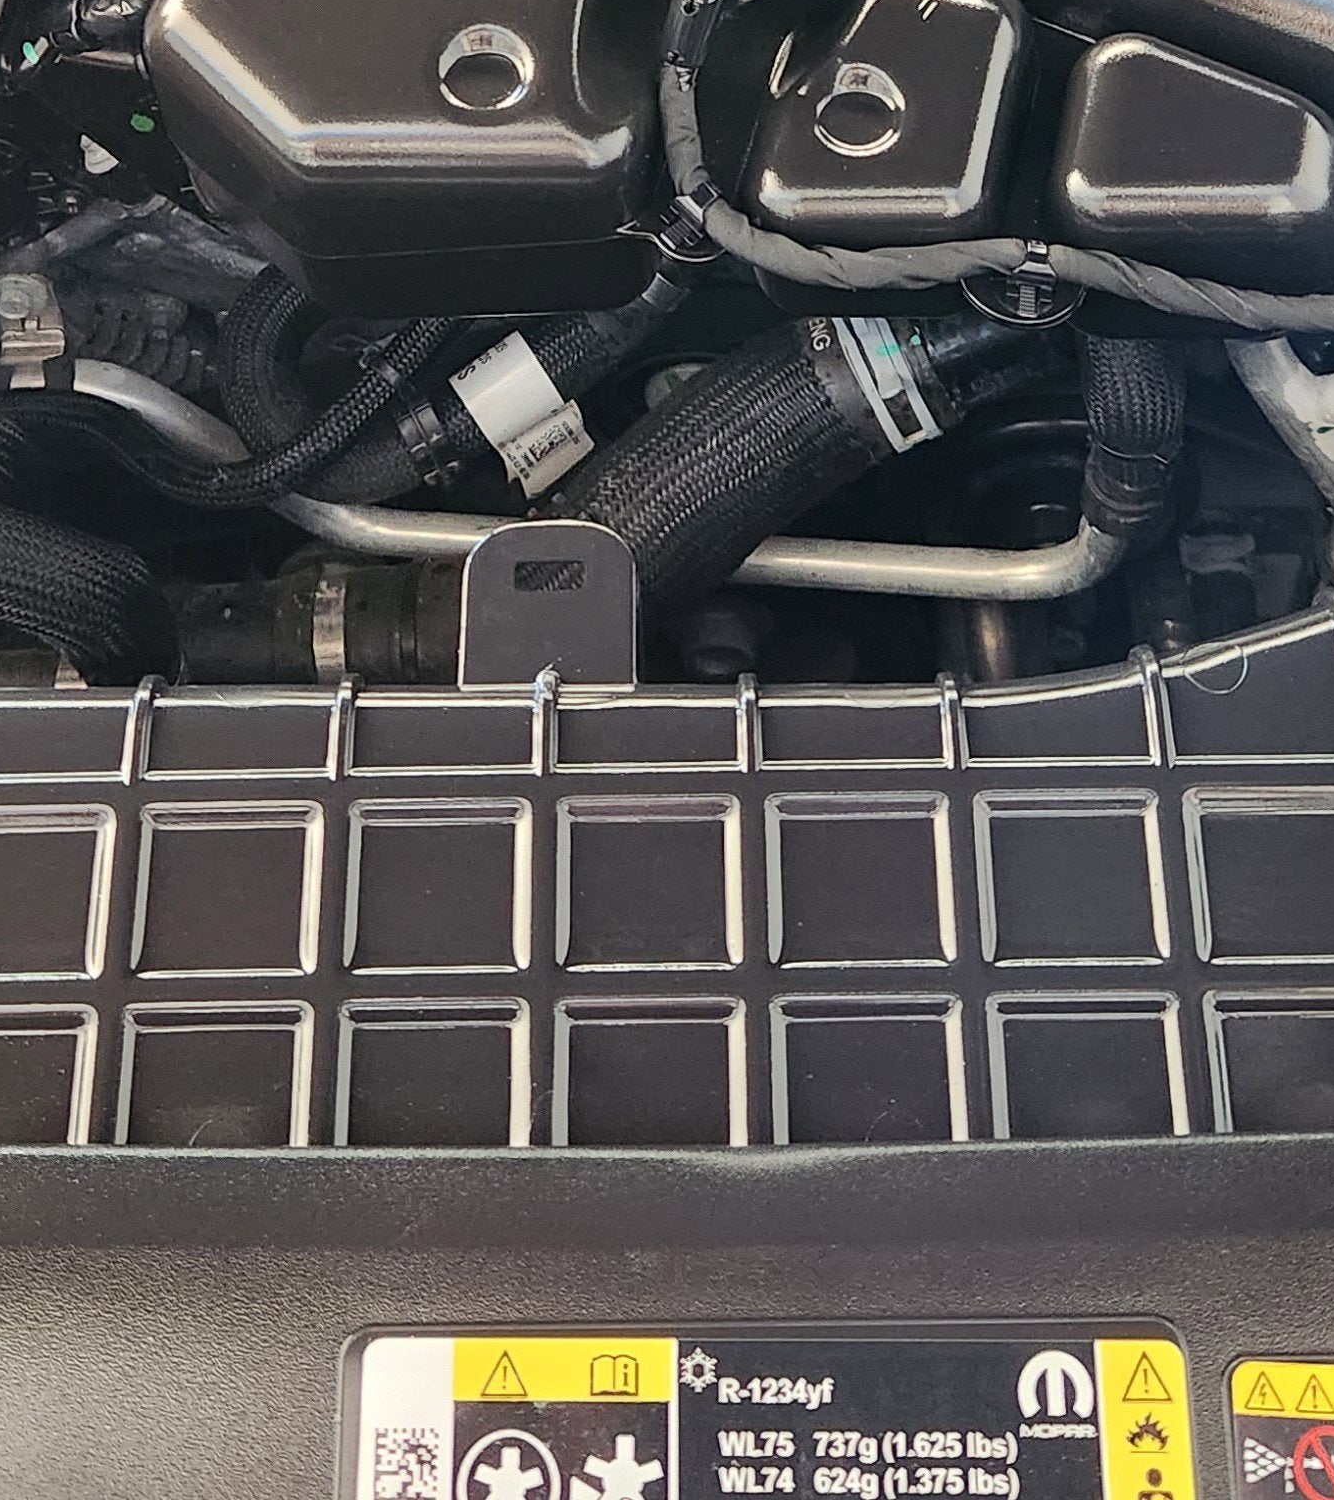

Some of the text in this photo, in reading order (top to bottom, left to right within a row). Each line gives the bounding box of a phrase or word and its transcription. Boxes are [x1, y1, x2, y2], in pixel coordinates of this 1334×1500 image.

[717, 1377, 834, 1410] R-1234yf
[717, 1430, 1019, 1464] WL75 737g (1.625 lbs)
[1018, 1423, 1097, 1439] MOPAR
[717, 1466, 1020, 1500] WL74 624g (1.375 lbs)
